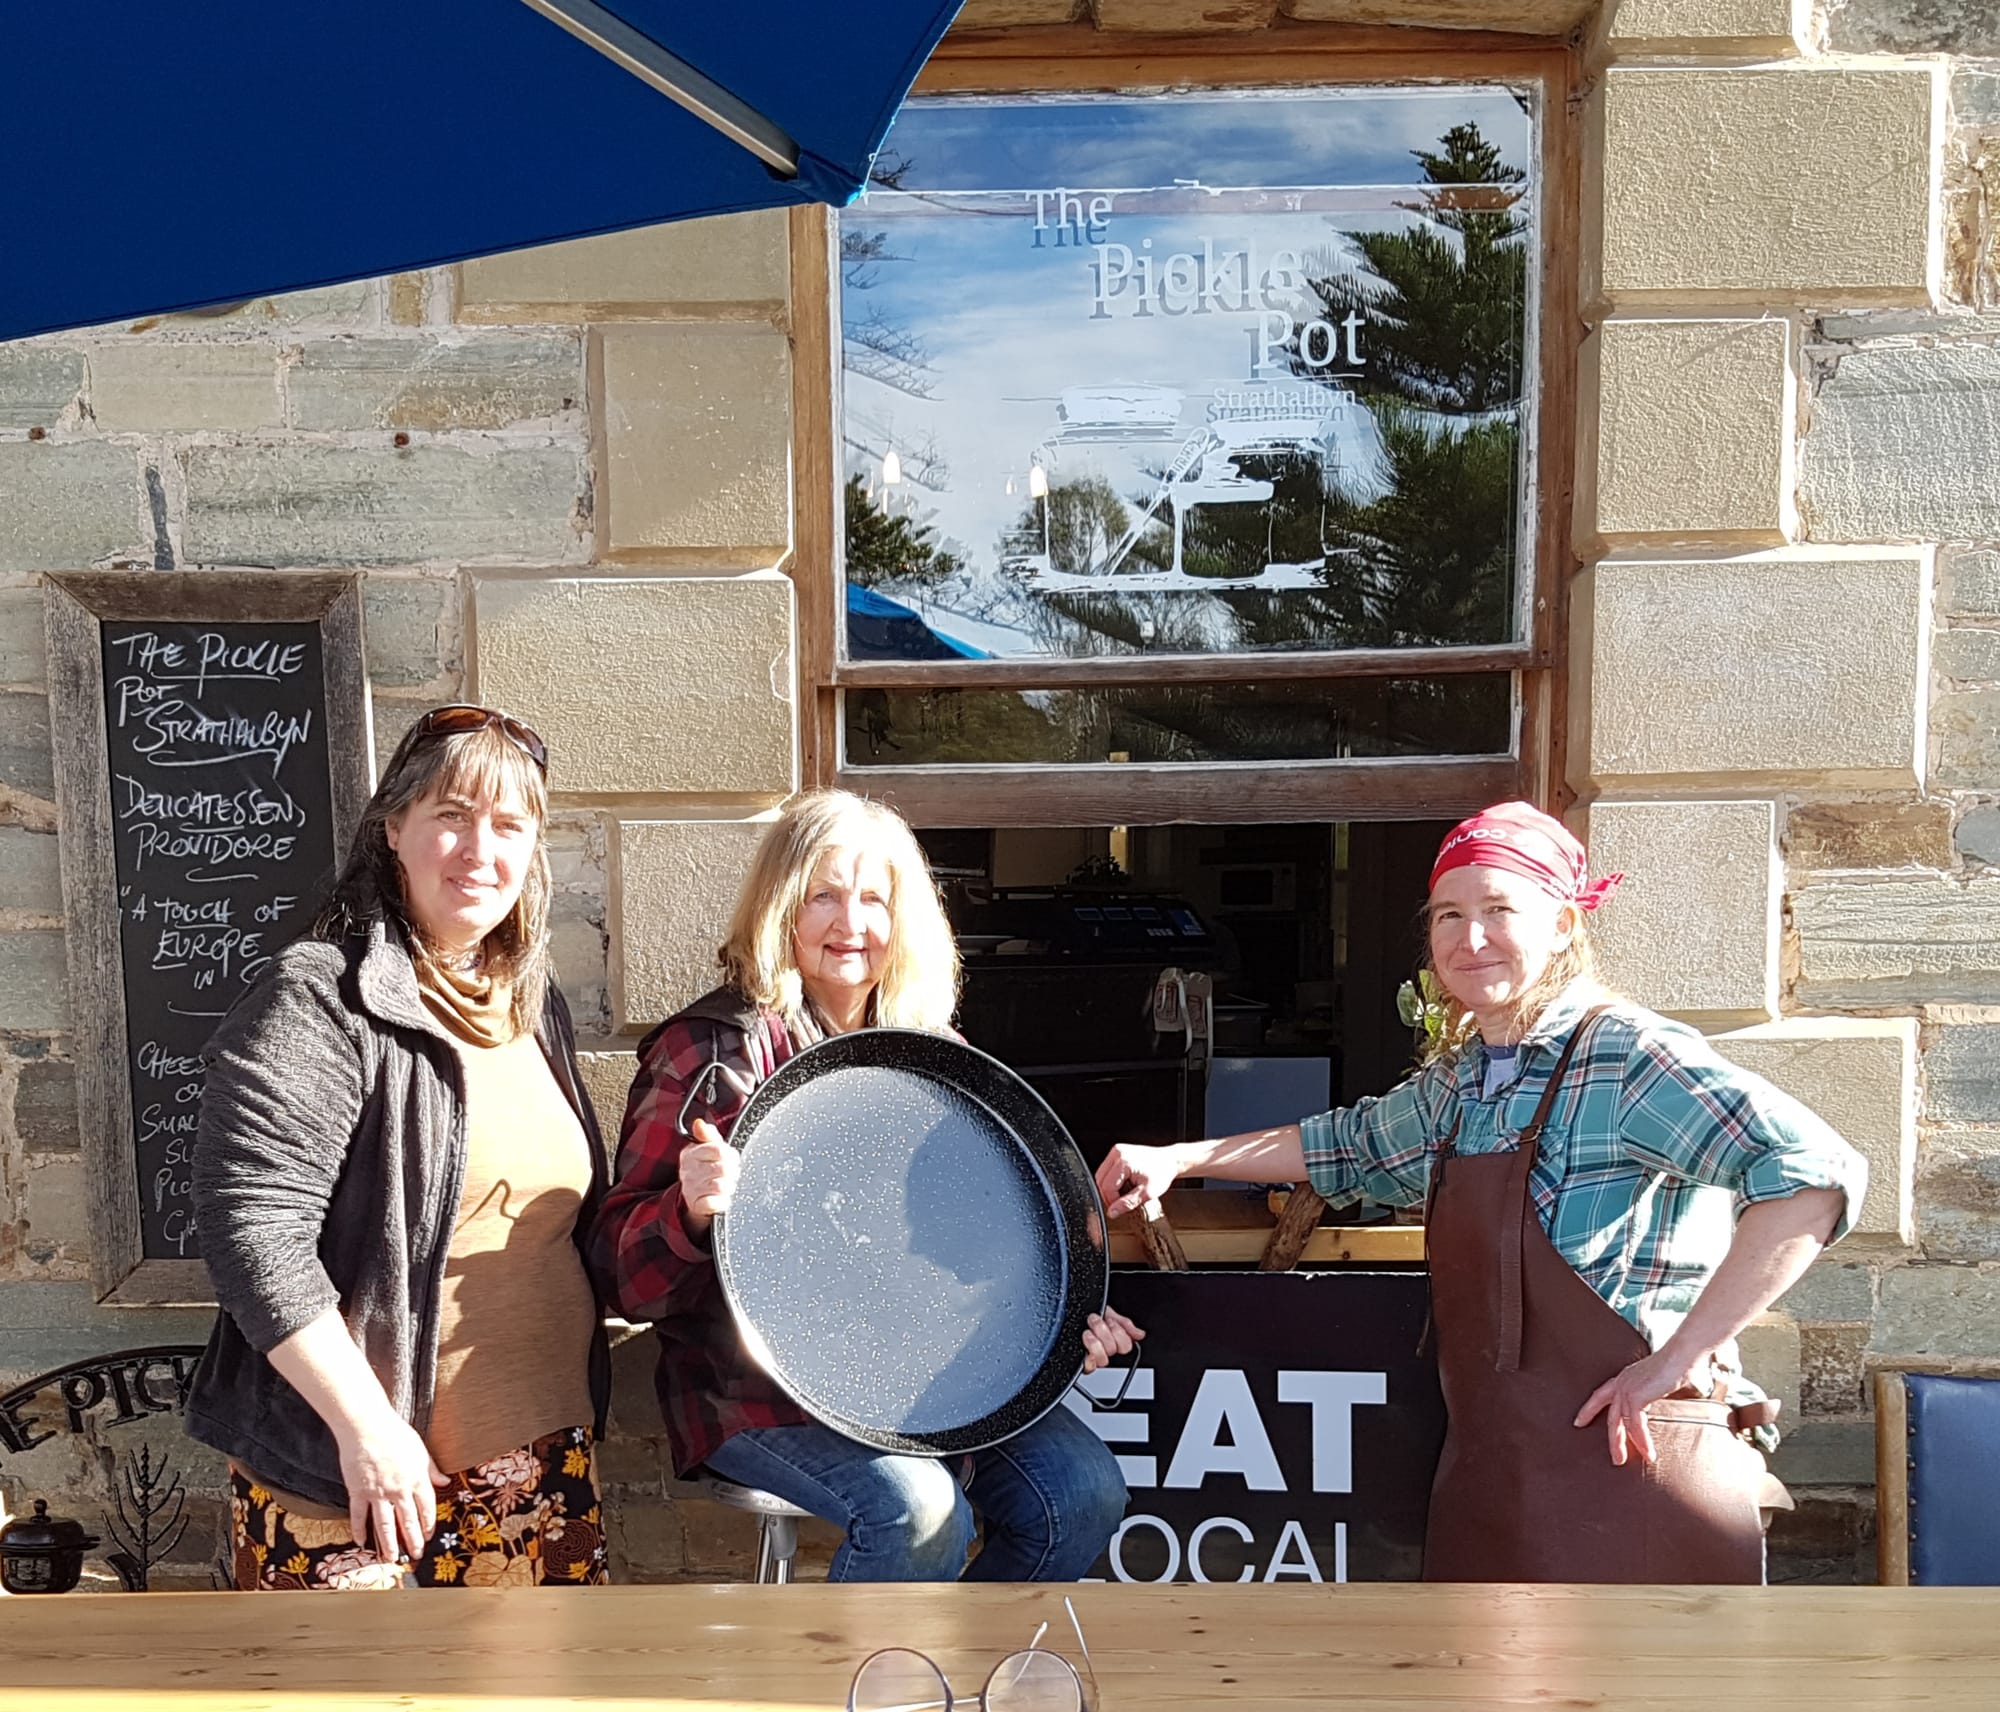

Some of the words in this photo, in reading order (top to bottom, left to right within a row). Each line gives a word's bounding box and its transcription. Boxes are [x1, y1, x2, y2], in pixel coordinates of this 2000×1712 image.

[1025, 188, 1112, 230] The
[1092, 237, 1306, 302] Pickle
[1253, 309, 1366, 369] Pot
[1213, 385, 1356, 411] Strathalbyn
[112, 632, 187, 672] THE
[197, 633, 306, 699] PICKLE
[114, 675, 184, 727] POT
[128, 822, 296, 872] PROVIDORE
[154, 896, 236, 924] TOUCH
[254, 896, 299, 922] OF
[153, 929, 264, 978] EUROPE
[1060, 1367, 1388, 1494] EAT
